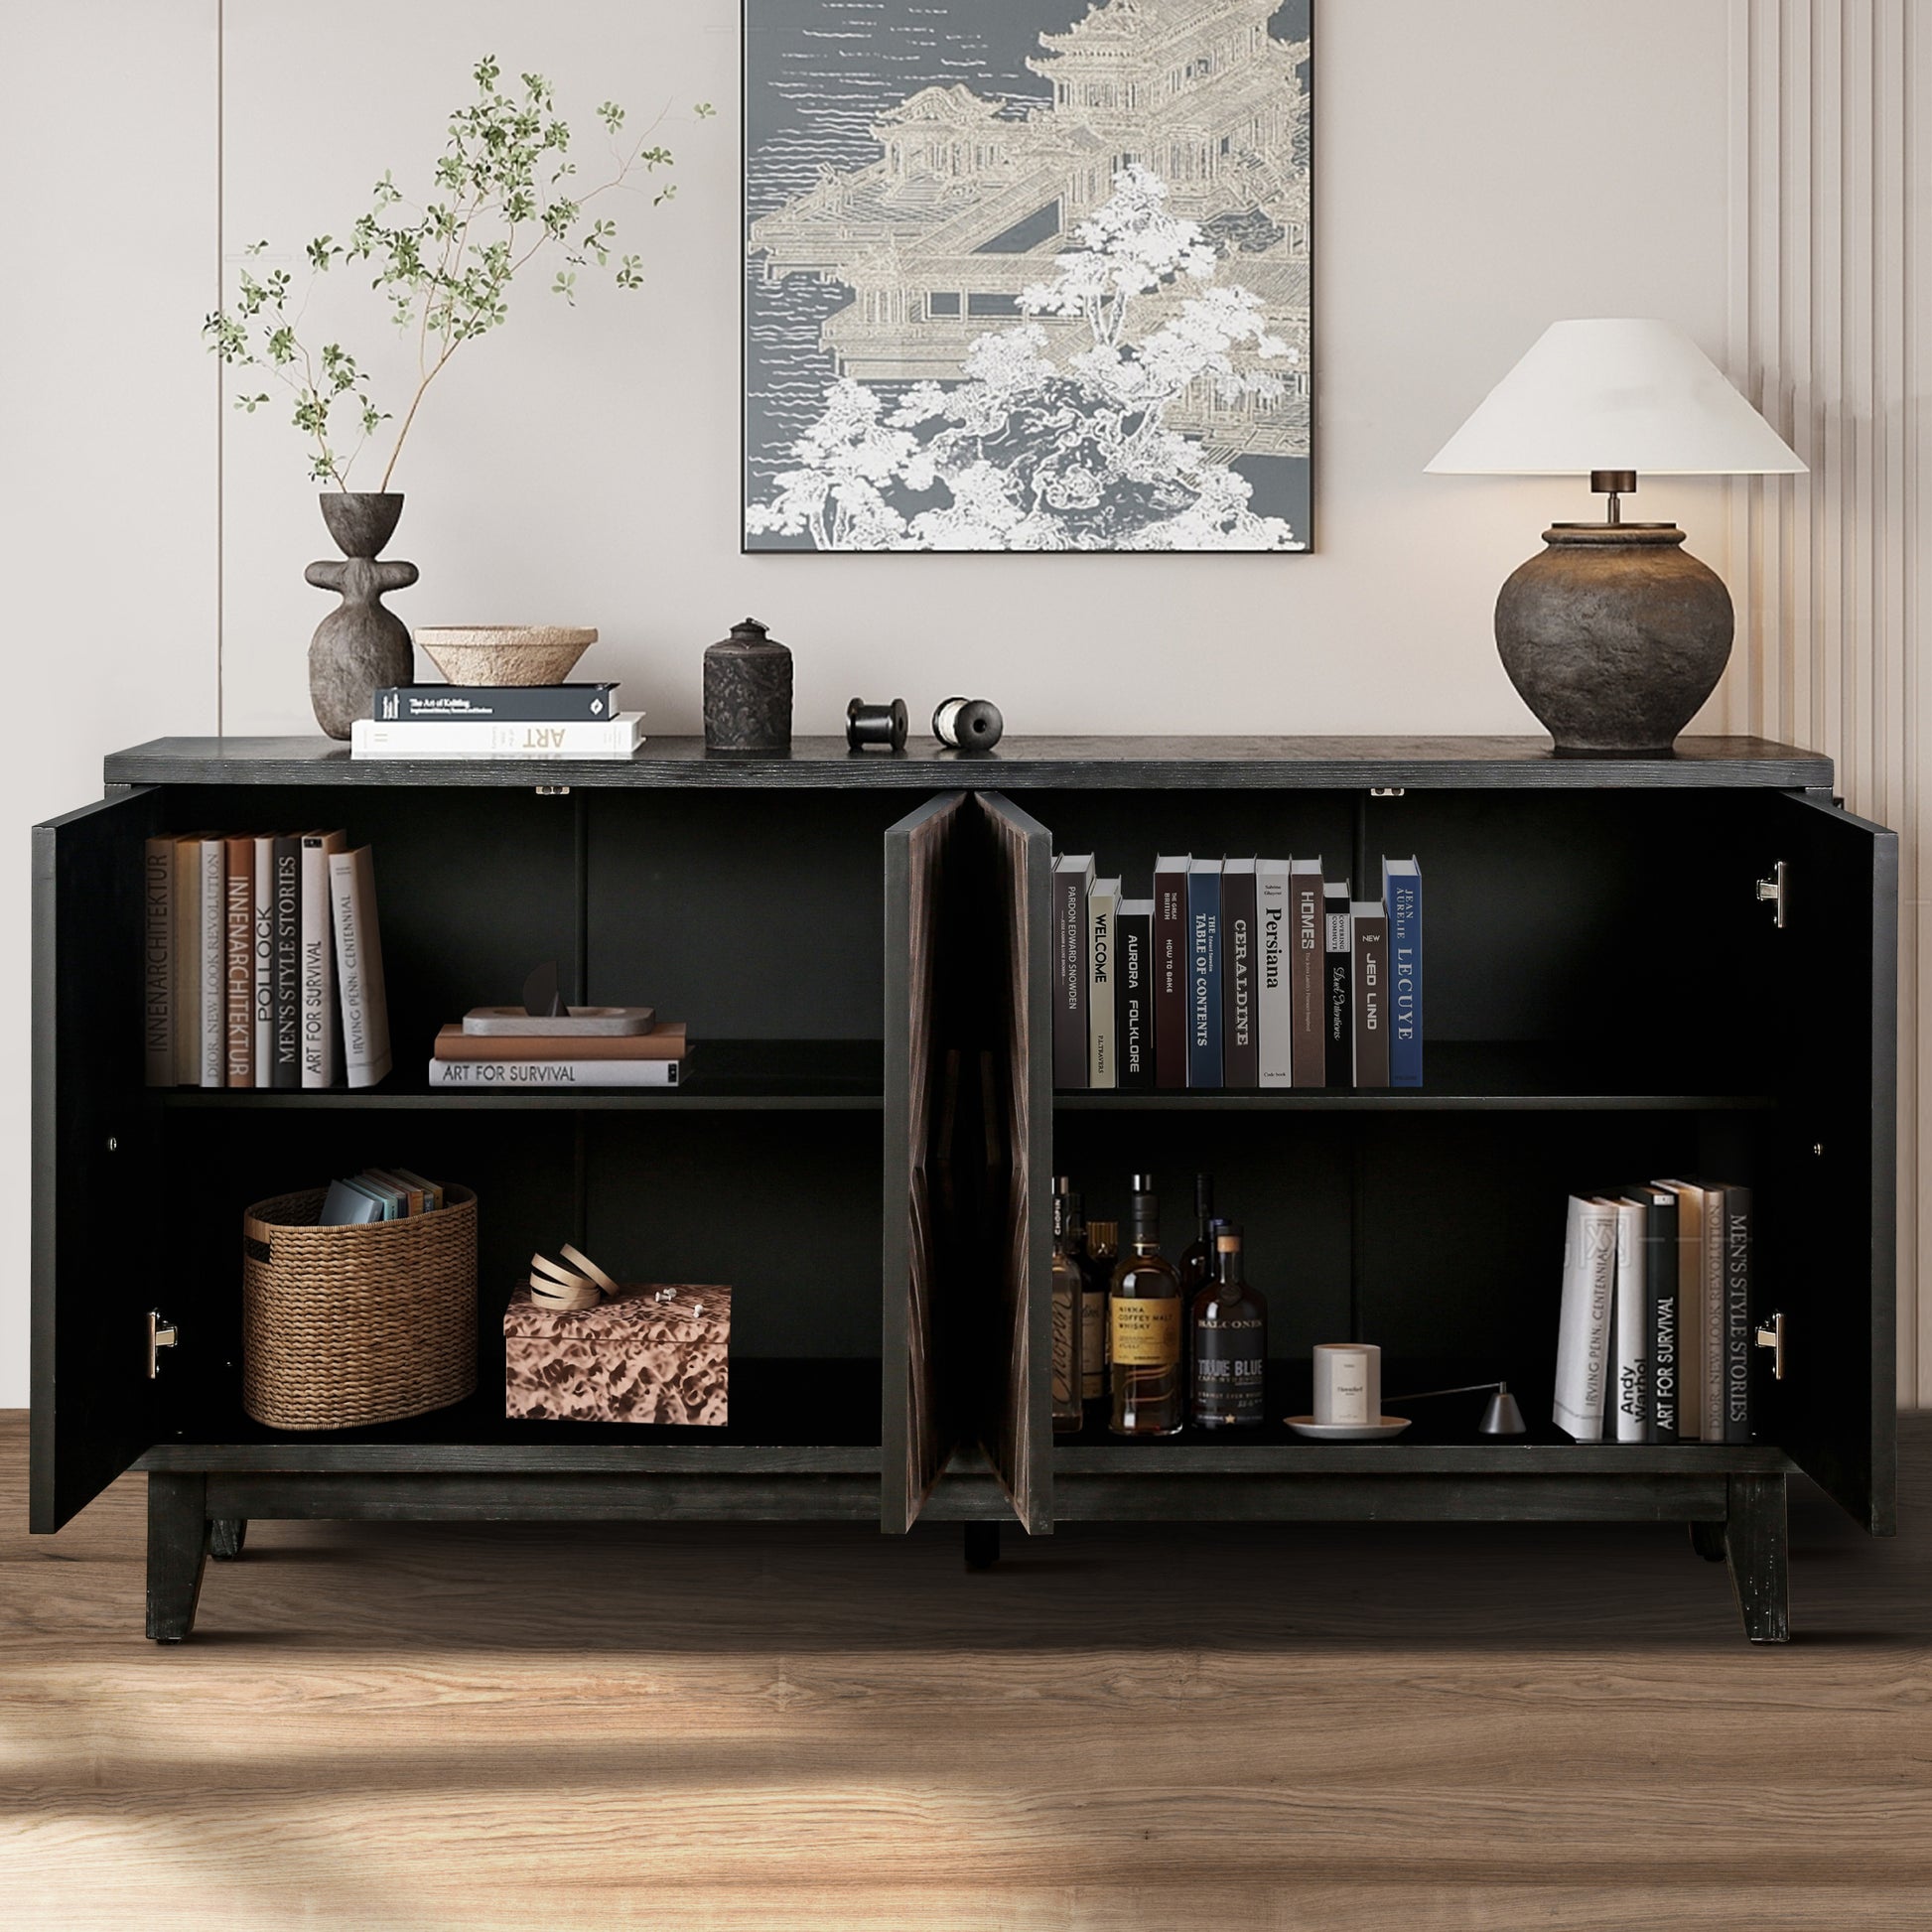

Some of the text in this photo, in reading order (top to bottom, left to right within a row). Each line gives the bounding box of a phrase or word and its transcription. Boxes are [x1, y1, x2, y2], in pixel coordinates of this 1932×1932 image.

[523, 728, 566, 749] ART
[206, 852, 221, 950] REVOLUTION
[341, 895, 357, 969] CENTENNIAL
[1301, 892, 1314, 950] HOMES
[1396, 888, 1405, 939] AURELIE
[1405, 889, 1414, 919] JEAN
[149, 854, 168, 1053] INNENARCHITEKTUR
[207, 954, 220, 996] LOOK
[227, 875, 249, 1076] INNENARCHITEKTUR
[256, 905, 273, 1022] POLLOCK
[278, 856, 296, 1064] MEN'S STYLE STORIES
[1067, 886, 1078, 1010] PARDON EDWARD SNOWDEN
[1095, 913, 1107, 984] WELCOME
[1167, 959, 1173, 970] TO
[1196, 912, 1208, 1046] TABLE OF CONTENTS
[1234, 919, 1249, 1046] CERALDINE
[1266, 907, 1283, 989] Persiana
[207, 999, 220, 1034] NEW
[306, 940, 323, 1074] ART FOR SURVIVAL
[1128, 934, 1141, 1073] AURORA FOLKLORE
[1366, 952, 1378, 1031] JED LIND
[1398, 947, 1413, 1040] LECUYE
[348, 1010, 365, 1054] IRVING
[442, 1064, 576, 1082] ART FOR SURVIVAL
[1591, 1247, 1609, 1320] CENTENNIAL
[1710, 1203, 1722, 1301] REVOLUTION
[1709, 1306, 1722, 1346] LOOK
[1729, 1214, 1747, 1422] MEN'S STYLE STORIES
[1234, 1359, 1263, 1377] BLUE
[1585, 1362, 1600, 1407] IRVING
[1620, 1366, 1637, 1416] Andy
[1634, 1358, 1647, 1423] Warhol
[1657, 1297, 1675, 1430] ART FOR SURVIVAL
[1709, 1349, 1722, 1384] NEW
